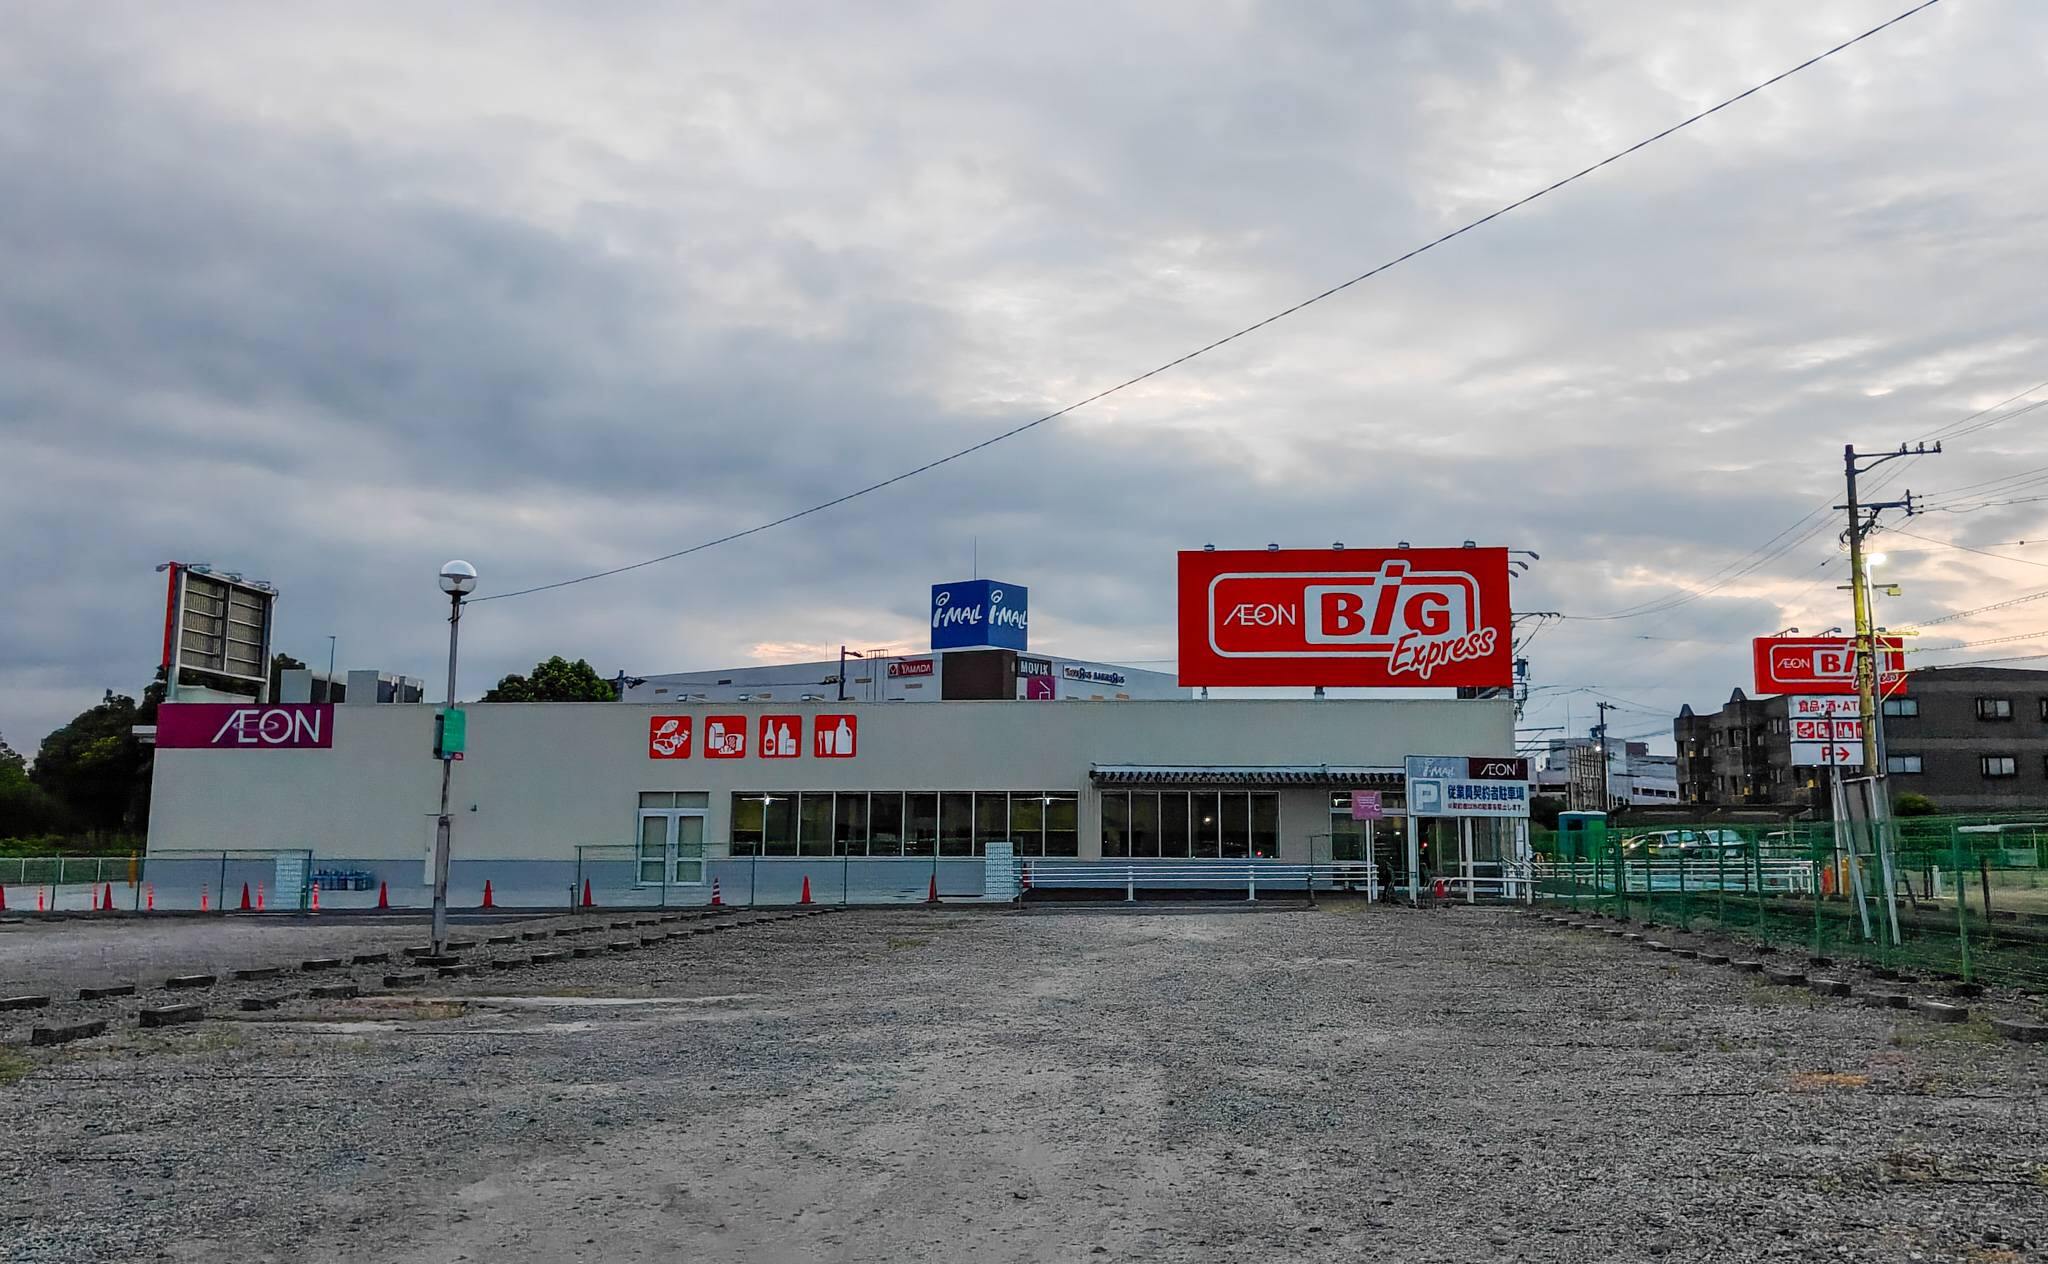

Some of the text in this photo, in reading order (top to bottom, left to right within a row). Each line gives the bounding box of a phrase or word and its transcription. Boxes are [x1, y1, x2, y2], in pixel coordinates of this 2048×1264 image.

[1390, 629, 1496, 678] Express
[901, 663, 931, 675] YAMADA
[1821, 746, 1832, 762] P
[1415, 783, 1438, 810] P
[1447, 784, 1525, 801] 従業員契約者駐車場
